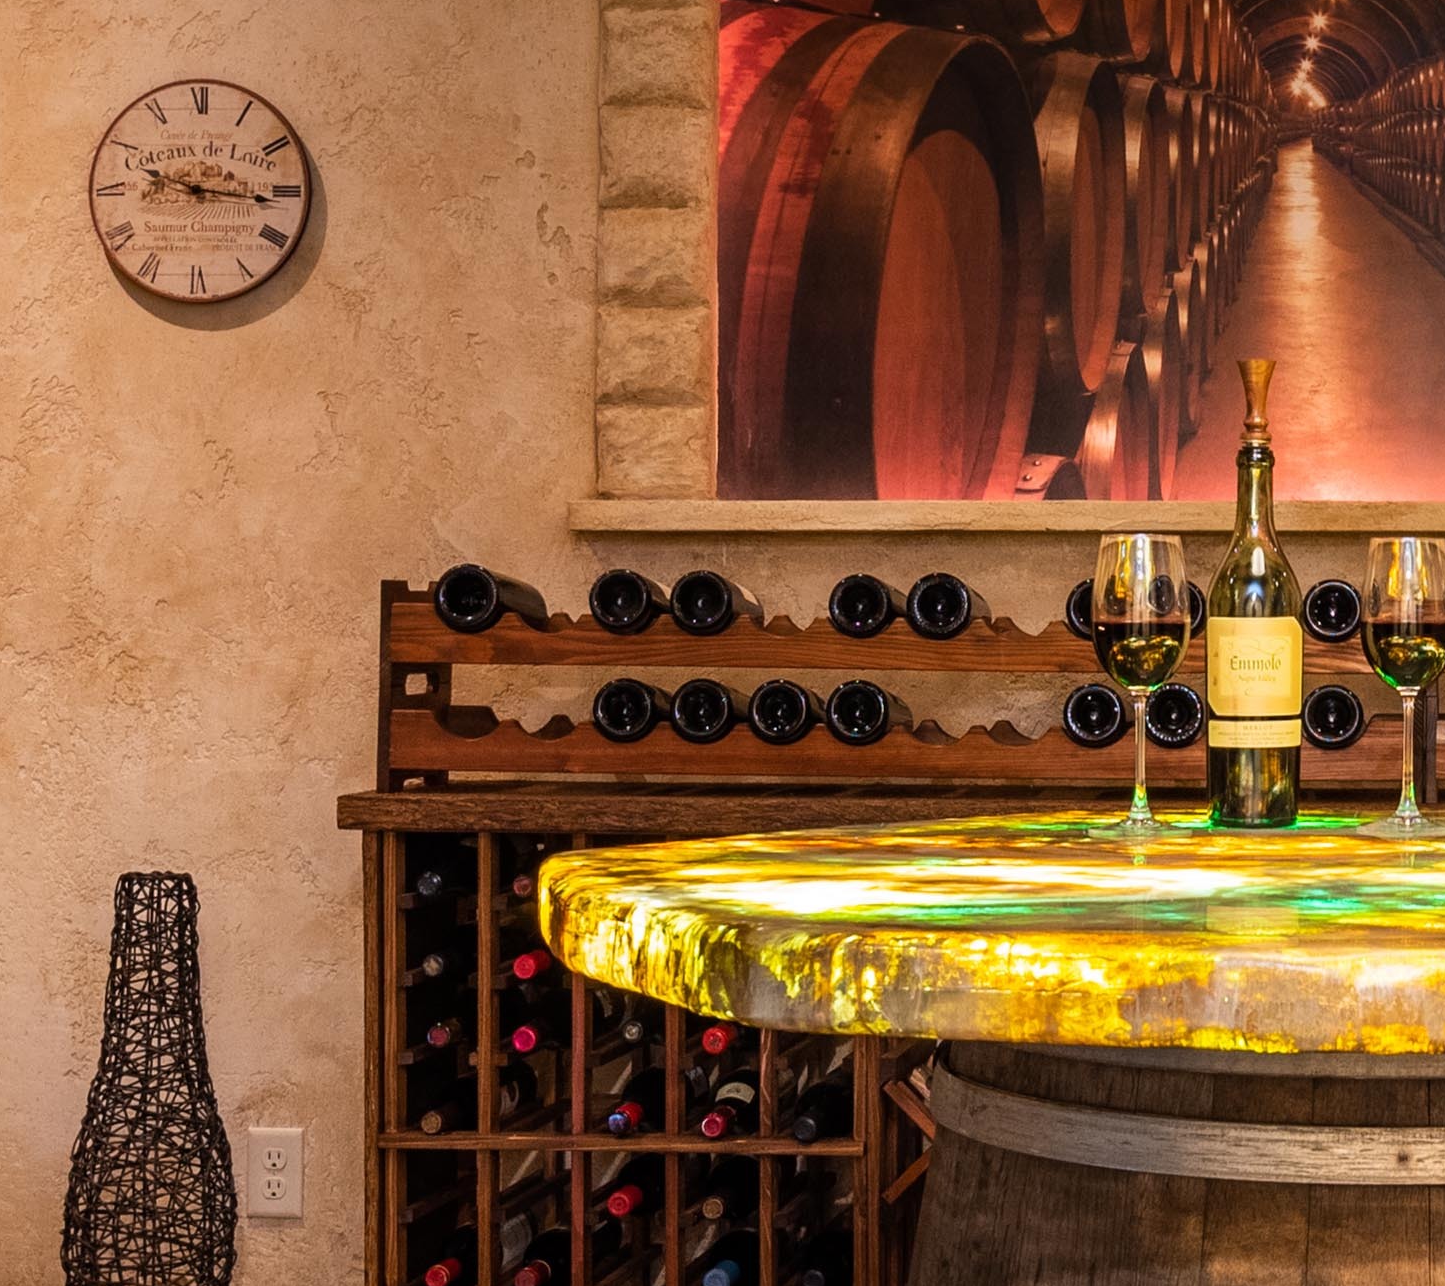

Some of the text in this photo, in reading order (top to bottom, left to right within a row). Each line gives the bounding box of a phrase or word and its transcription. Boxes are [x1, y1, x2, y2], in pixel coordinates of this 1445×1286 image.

[202, 140, 224, 158] de
[230, 142, 277, 173] Loire
[143, 220, 256, 236] Saumur Champigny
[1230, 653, 1282, 671] Emmolo
